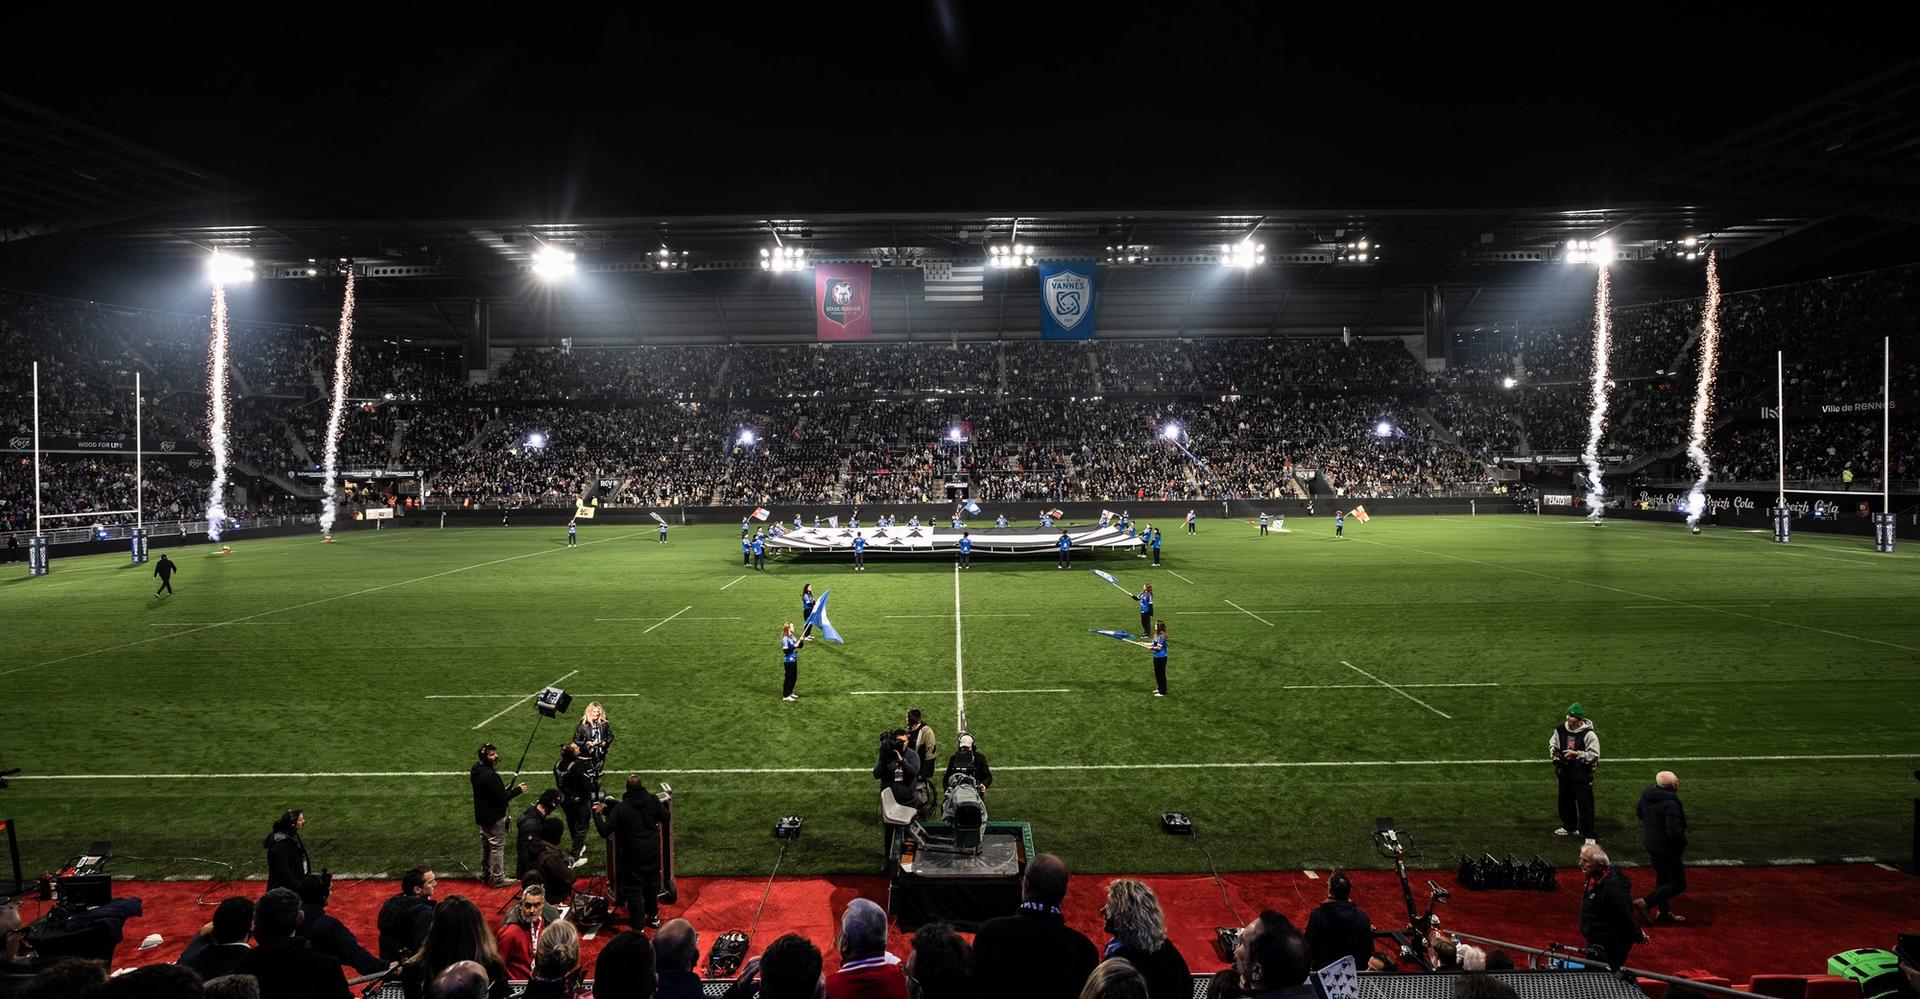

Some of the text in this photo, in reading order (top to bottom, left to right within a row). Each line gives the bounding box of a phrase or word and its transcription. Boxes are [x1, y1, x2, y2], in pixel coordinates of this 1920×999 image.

[1052, 282, 1085, 290] VANNES
[1822, 404, 1840, 413] Ville
[1842, 404, 1853, 412] de
[1734, 496, 1755, 509] Cola
